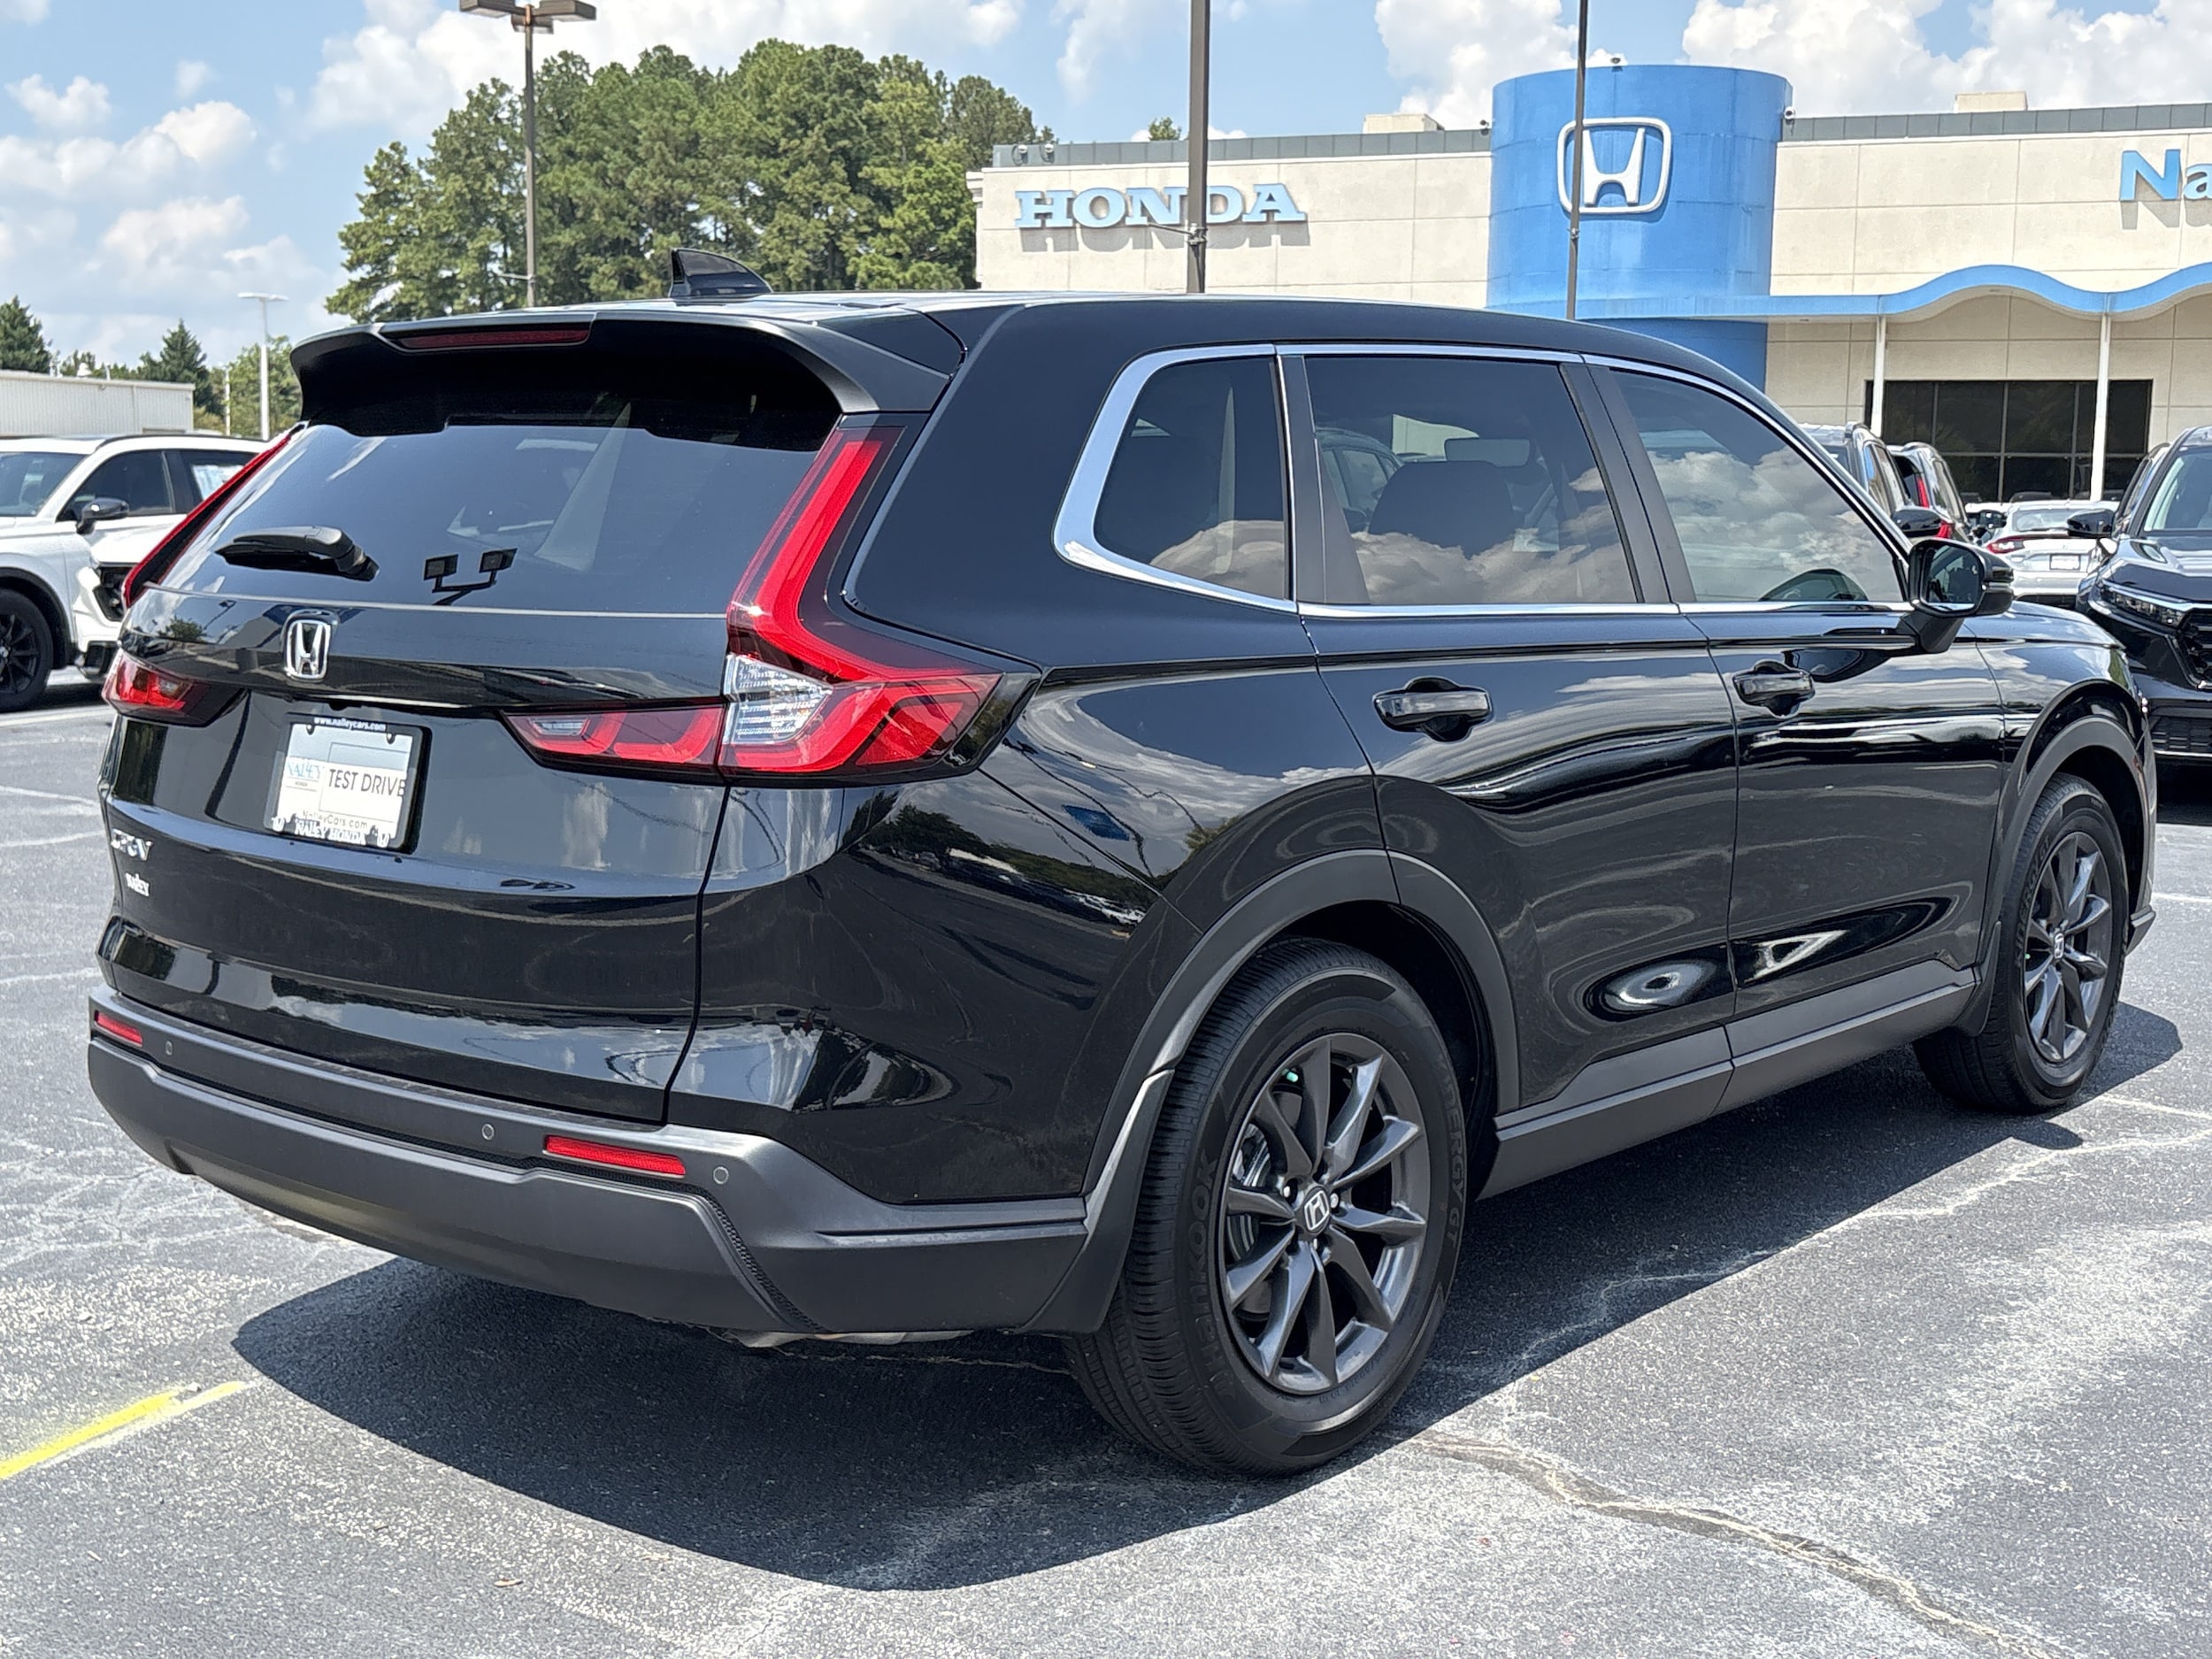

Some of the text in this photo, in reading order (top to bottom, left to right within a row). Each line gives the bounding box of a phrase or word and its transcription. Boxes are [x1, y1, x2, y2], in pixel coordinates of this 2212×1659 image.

[1015, 182, 1307, 228] HONDA
[328, 768, 407, 797] TEST DRIVE
